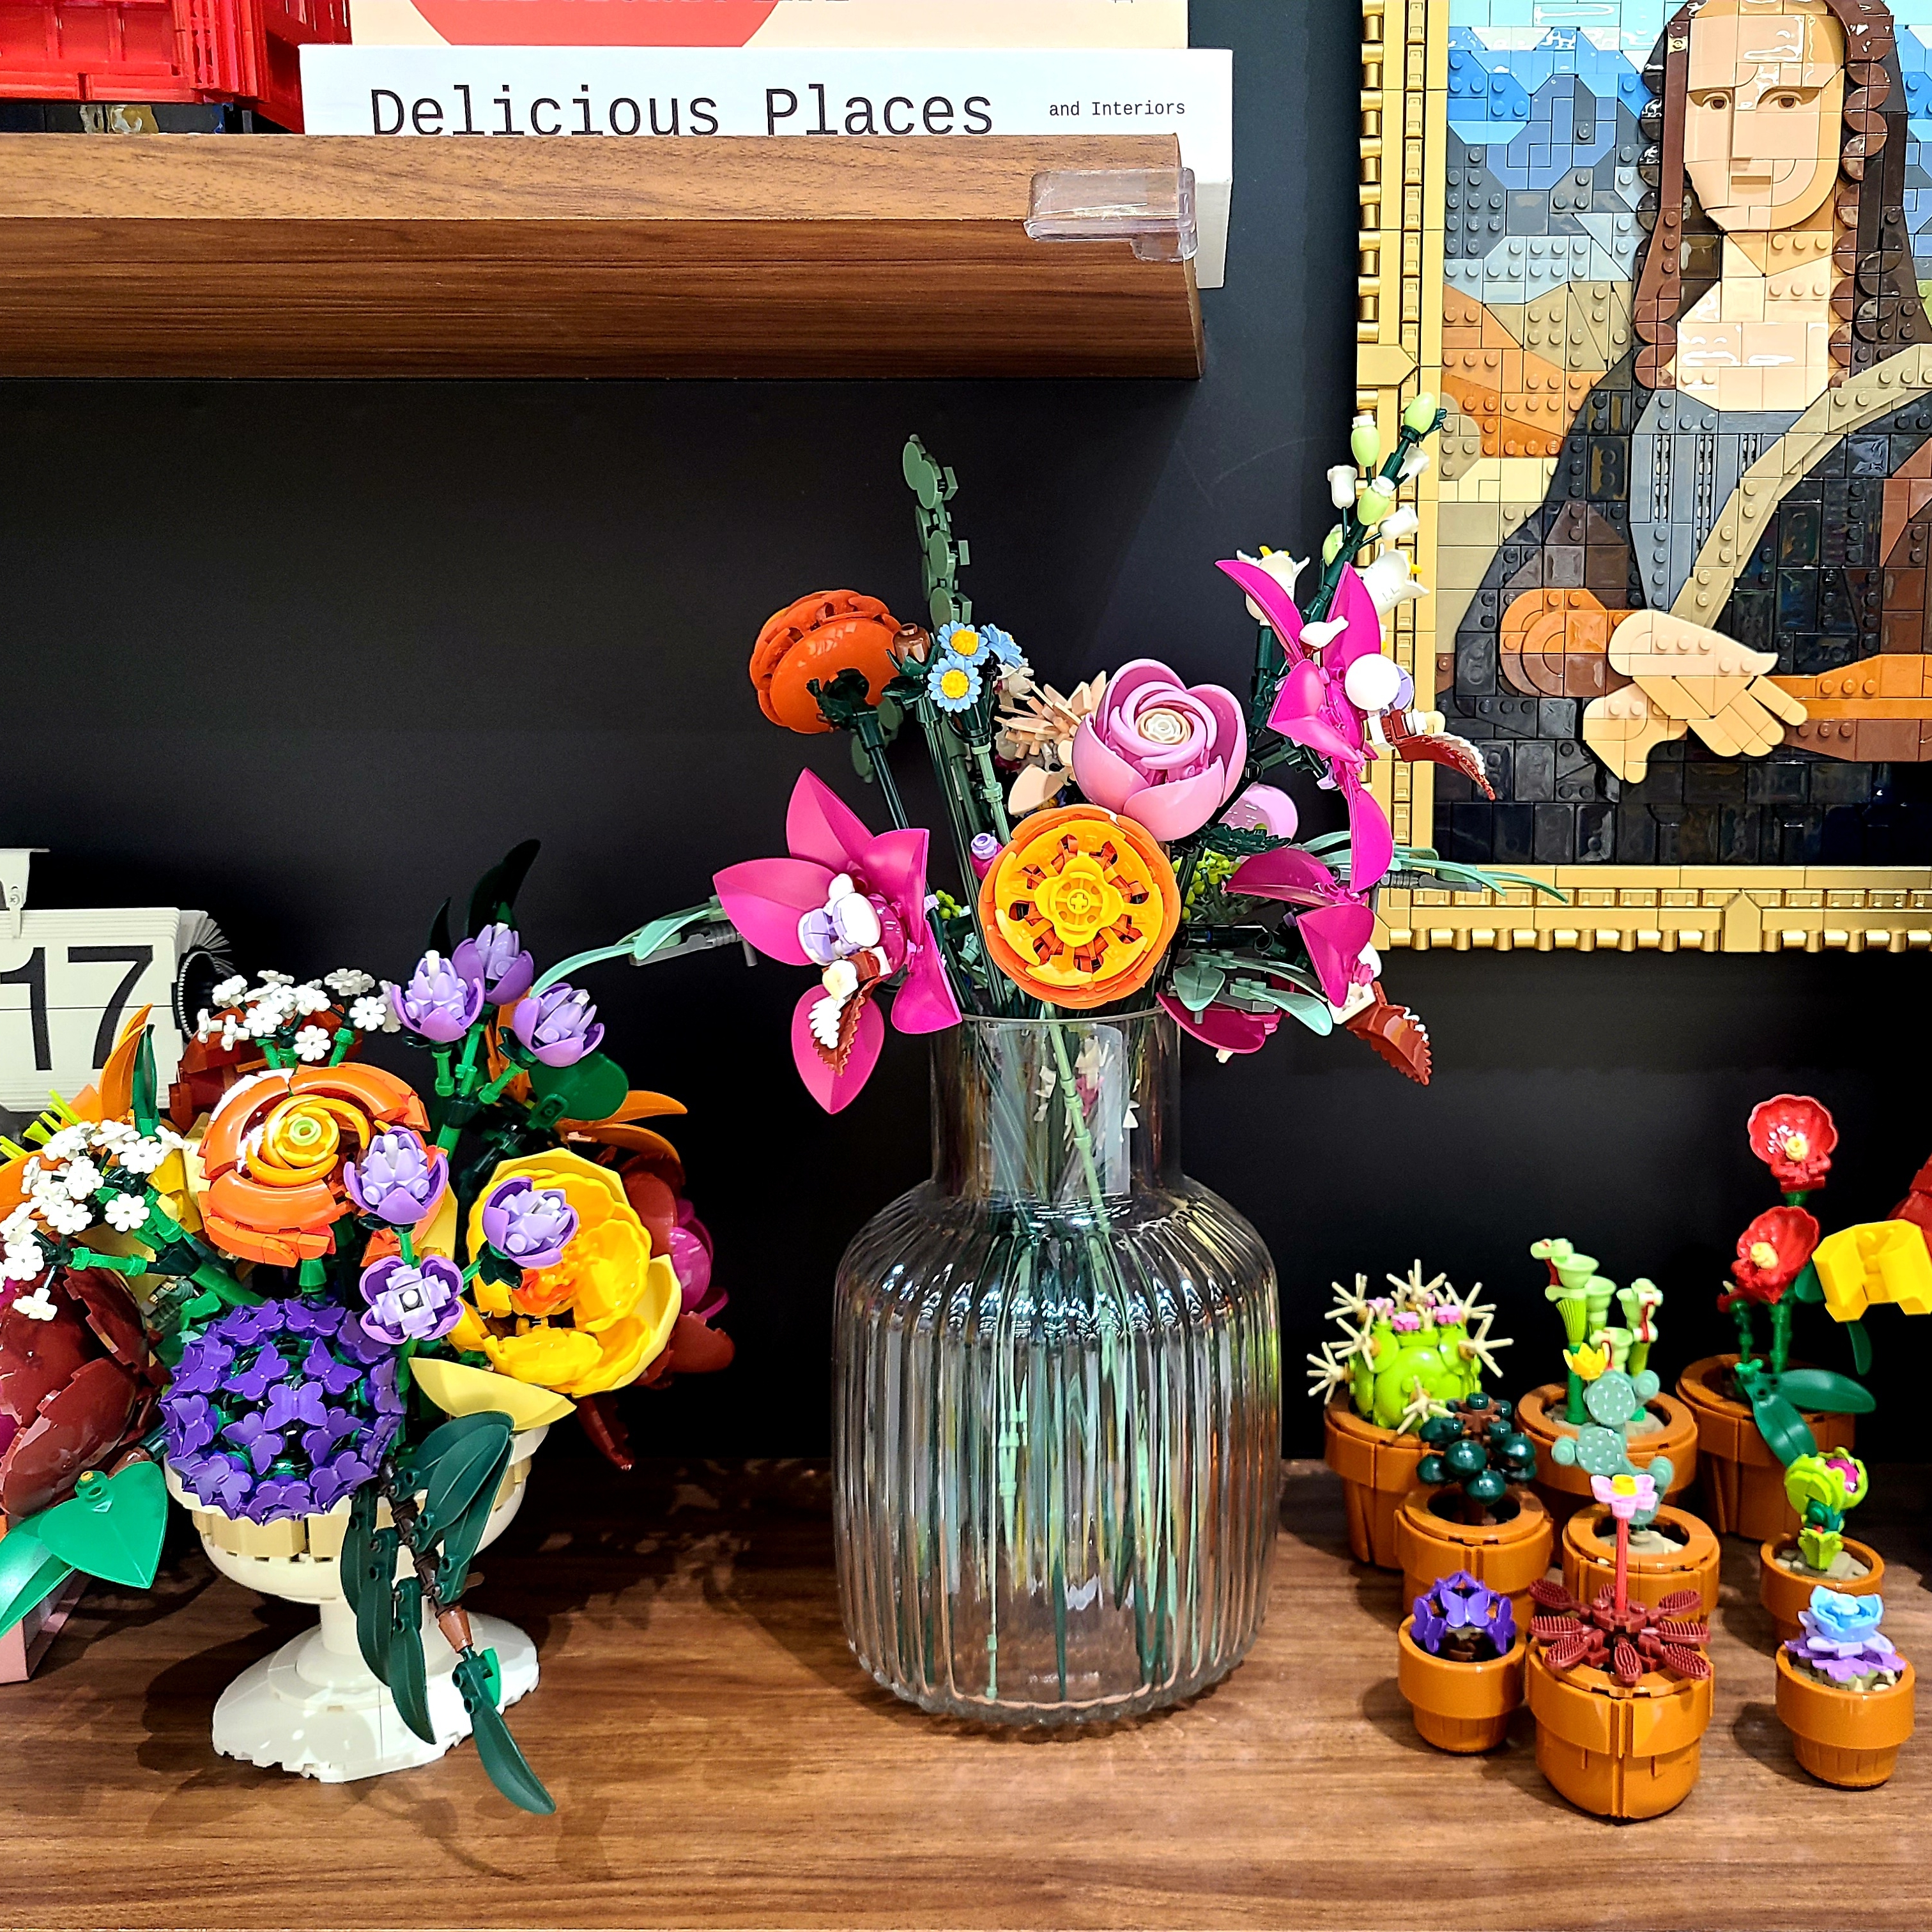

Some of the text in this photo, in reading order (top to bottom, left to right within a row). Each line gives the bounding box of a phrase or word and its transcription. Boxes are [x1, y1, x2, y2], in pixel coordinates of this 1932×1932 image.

[371, 84, 992, 135] Delicious Places
[1049, 100, 1185, 116] and Interiors
[0, 945, 153, 1071] 17
